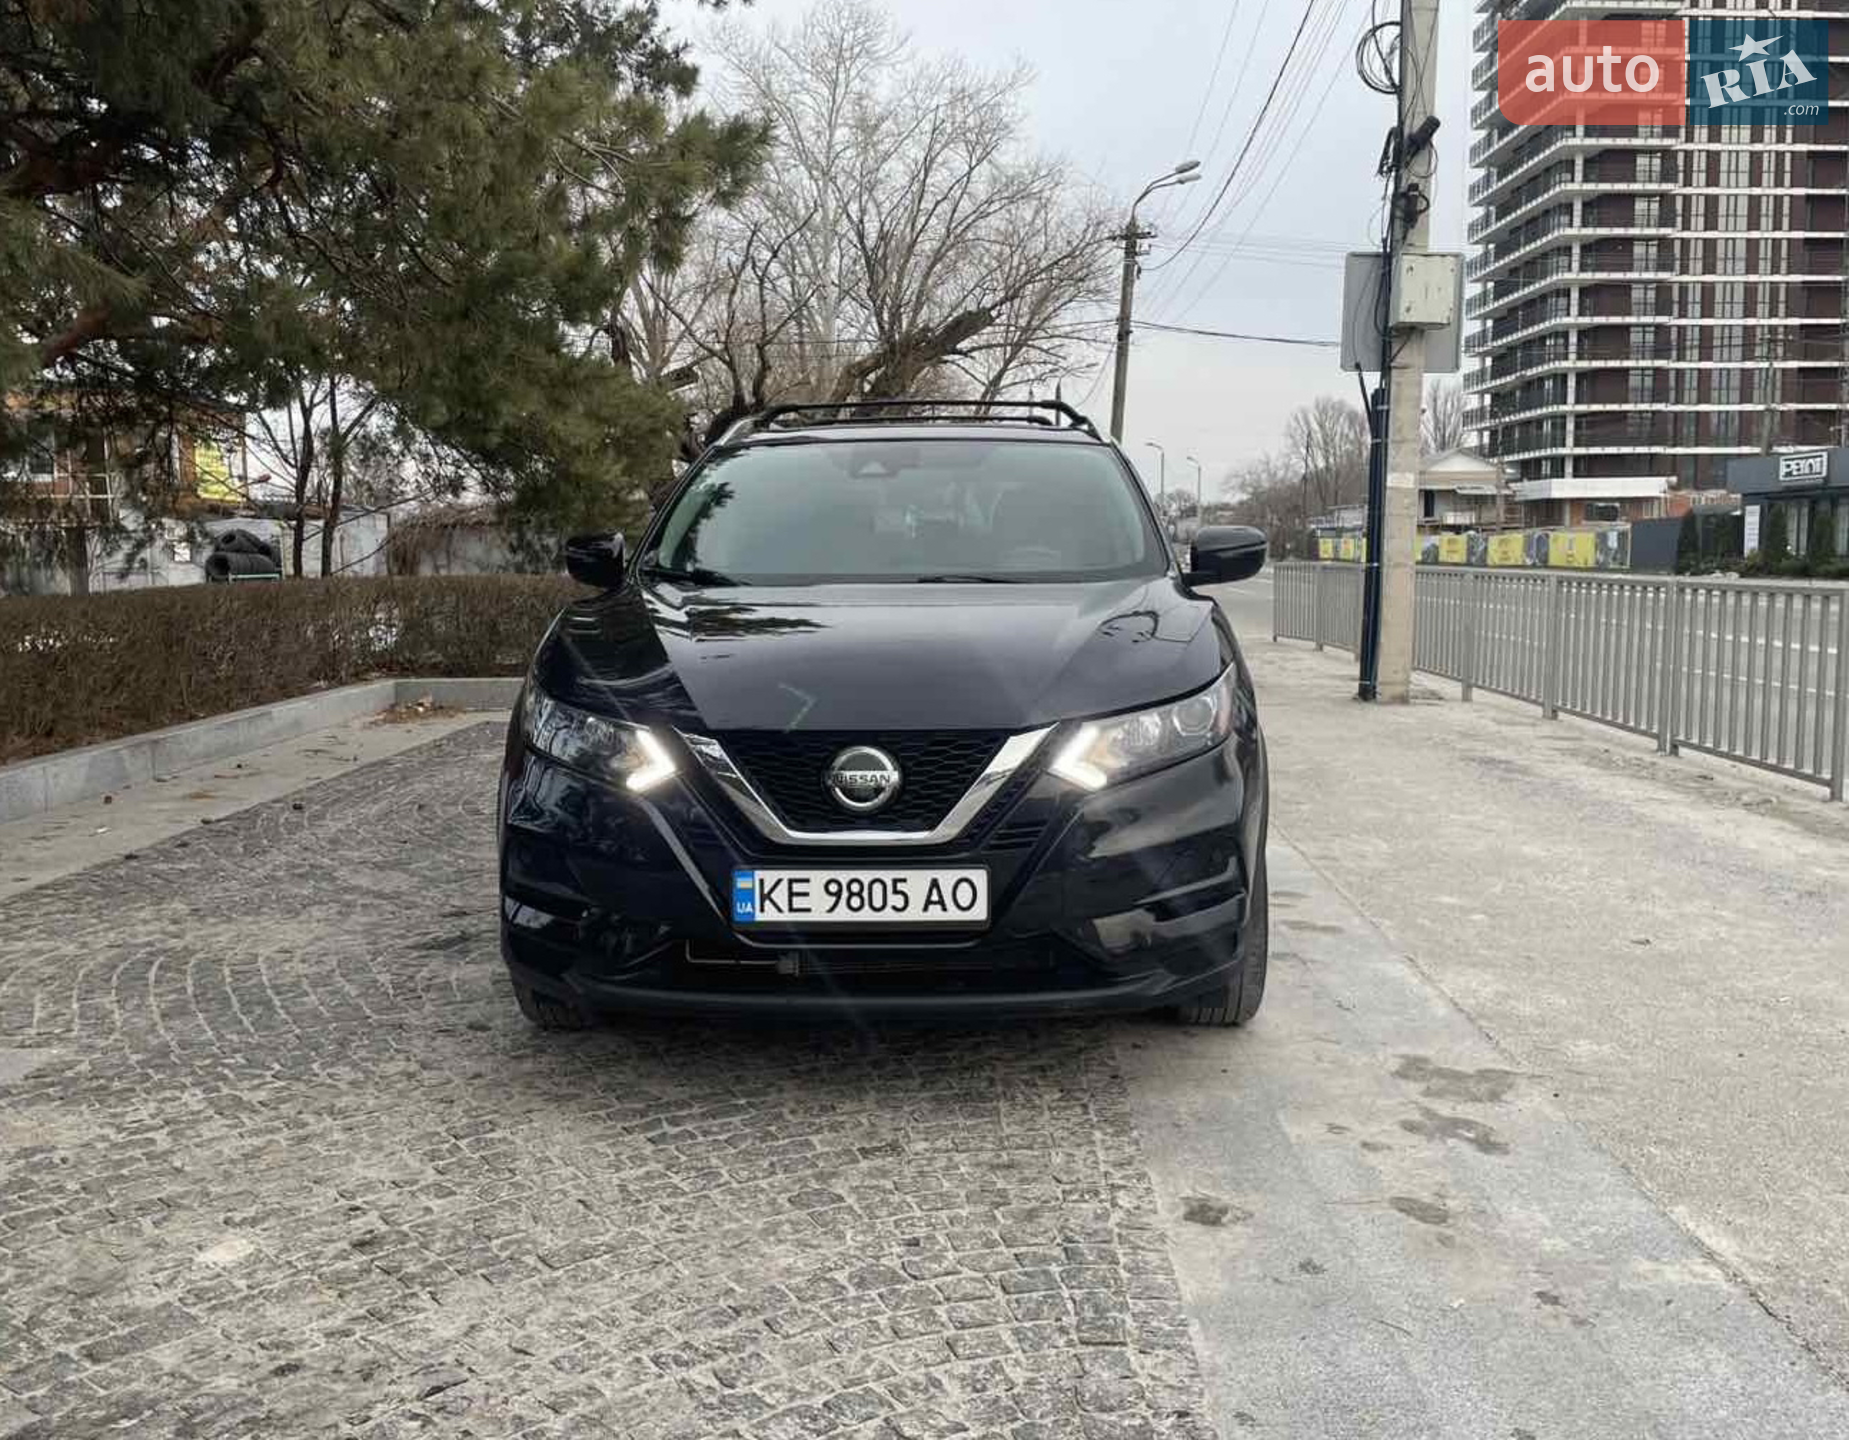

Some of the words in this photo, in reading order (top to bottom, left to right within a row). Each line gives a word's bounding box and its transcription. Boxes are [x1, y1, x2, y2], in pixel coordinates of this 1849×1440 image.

[834, 774, 891, 785] NISSAN
[759, 878, 811, 913] KE
[823, 878, 909, 913] 9805
[922, 877, 978, 913] AO
[737, 902, 753, 914] UA
